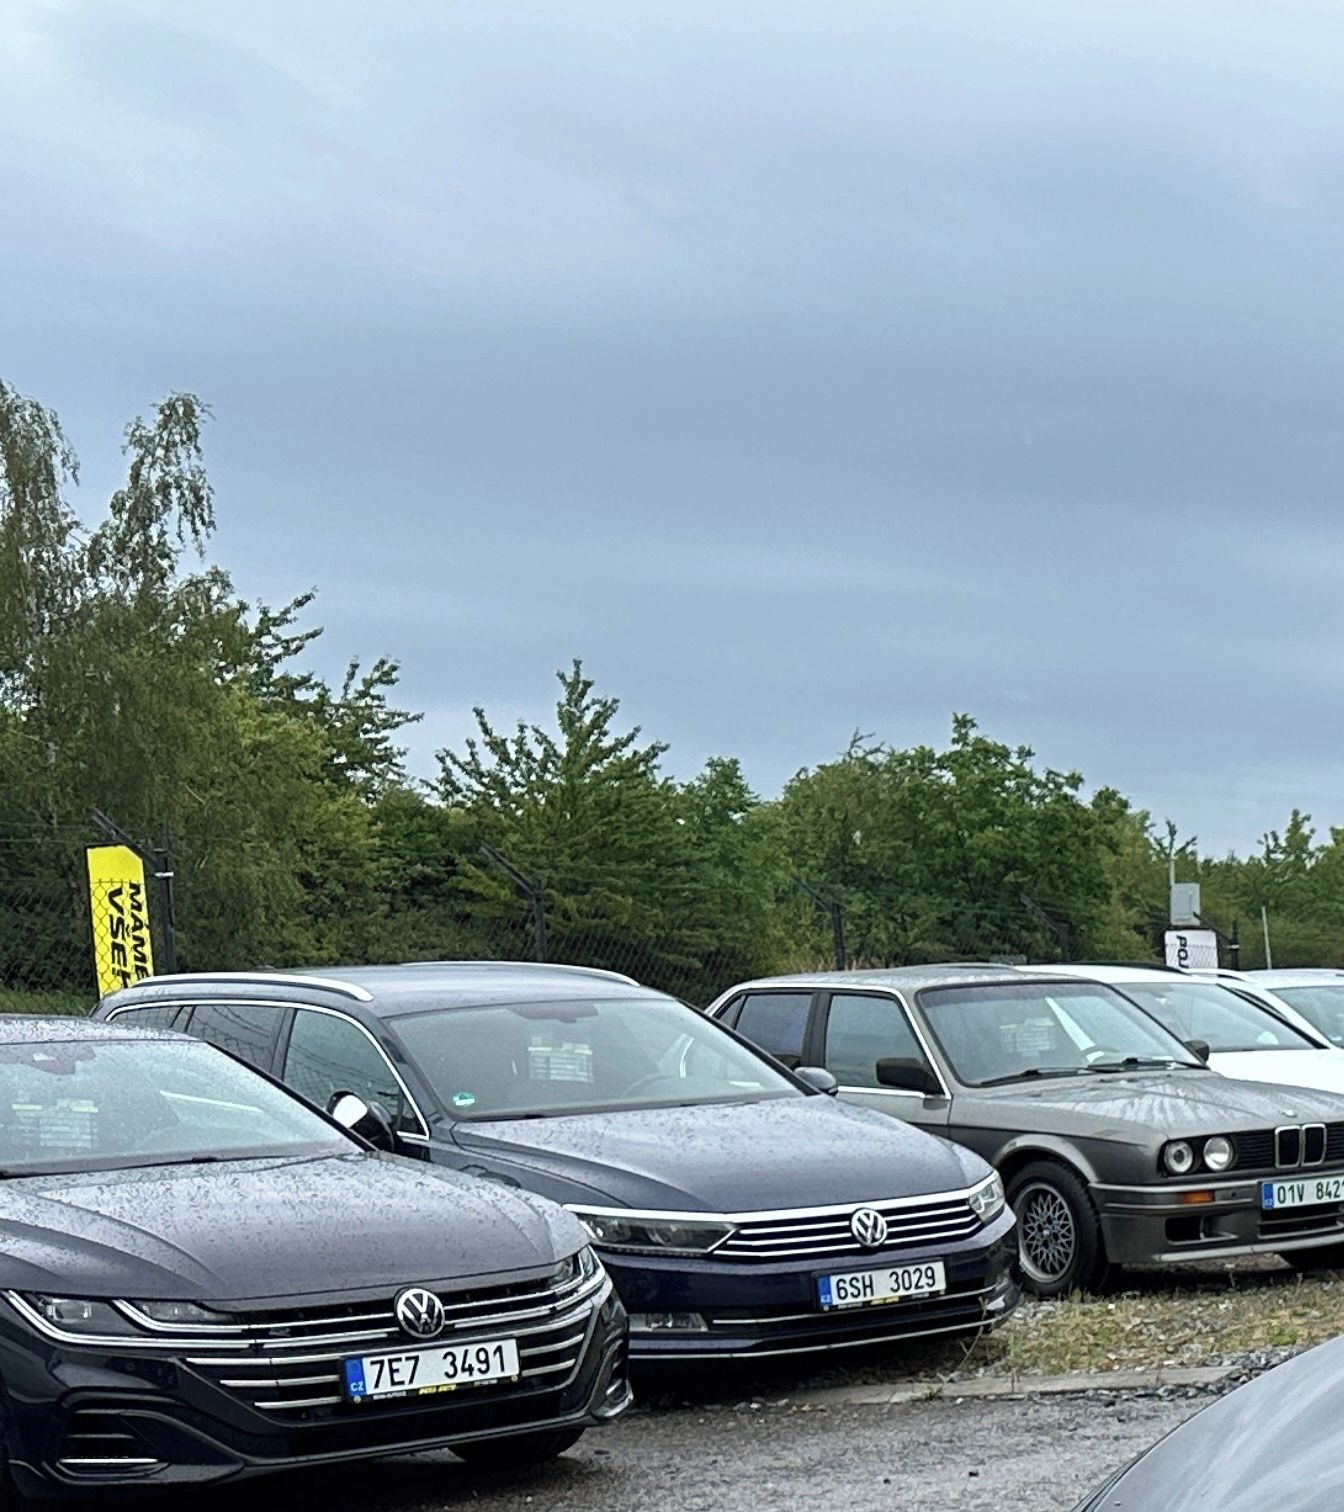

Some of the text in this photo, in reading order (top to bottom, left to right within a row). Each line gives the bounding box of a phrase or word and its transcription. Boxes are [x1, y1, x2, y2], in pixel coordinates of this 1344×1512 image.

[129, 882, 151, 981] MÁME
[1277, 1183, 1305, 1204] 01V
[836, 1266, 936, 1301] 6SH 3029
[369, 1345, 506, 1390] 7E7 3491
[350, 1380, 365, 1392] CZ
